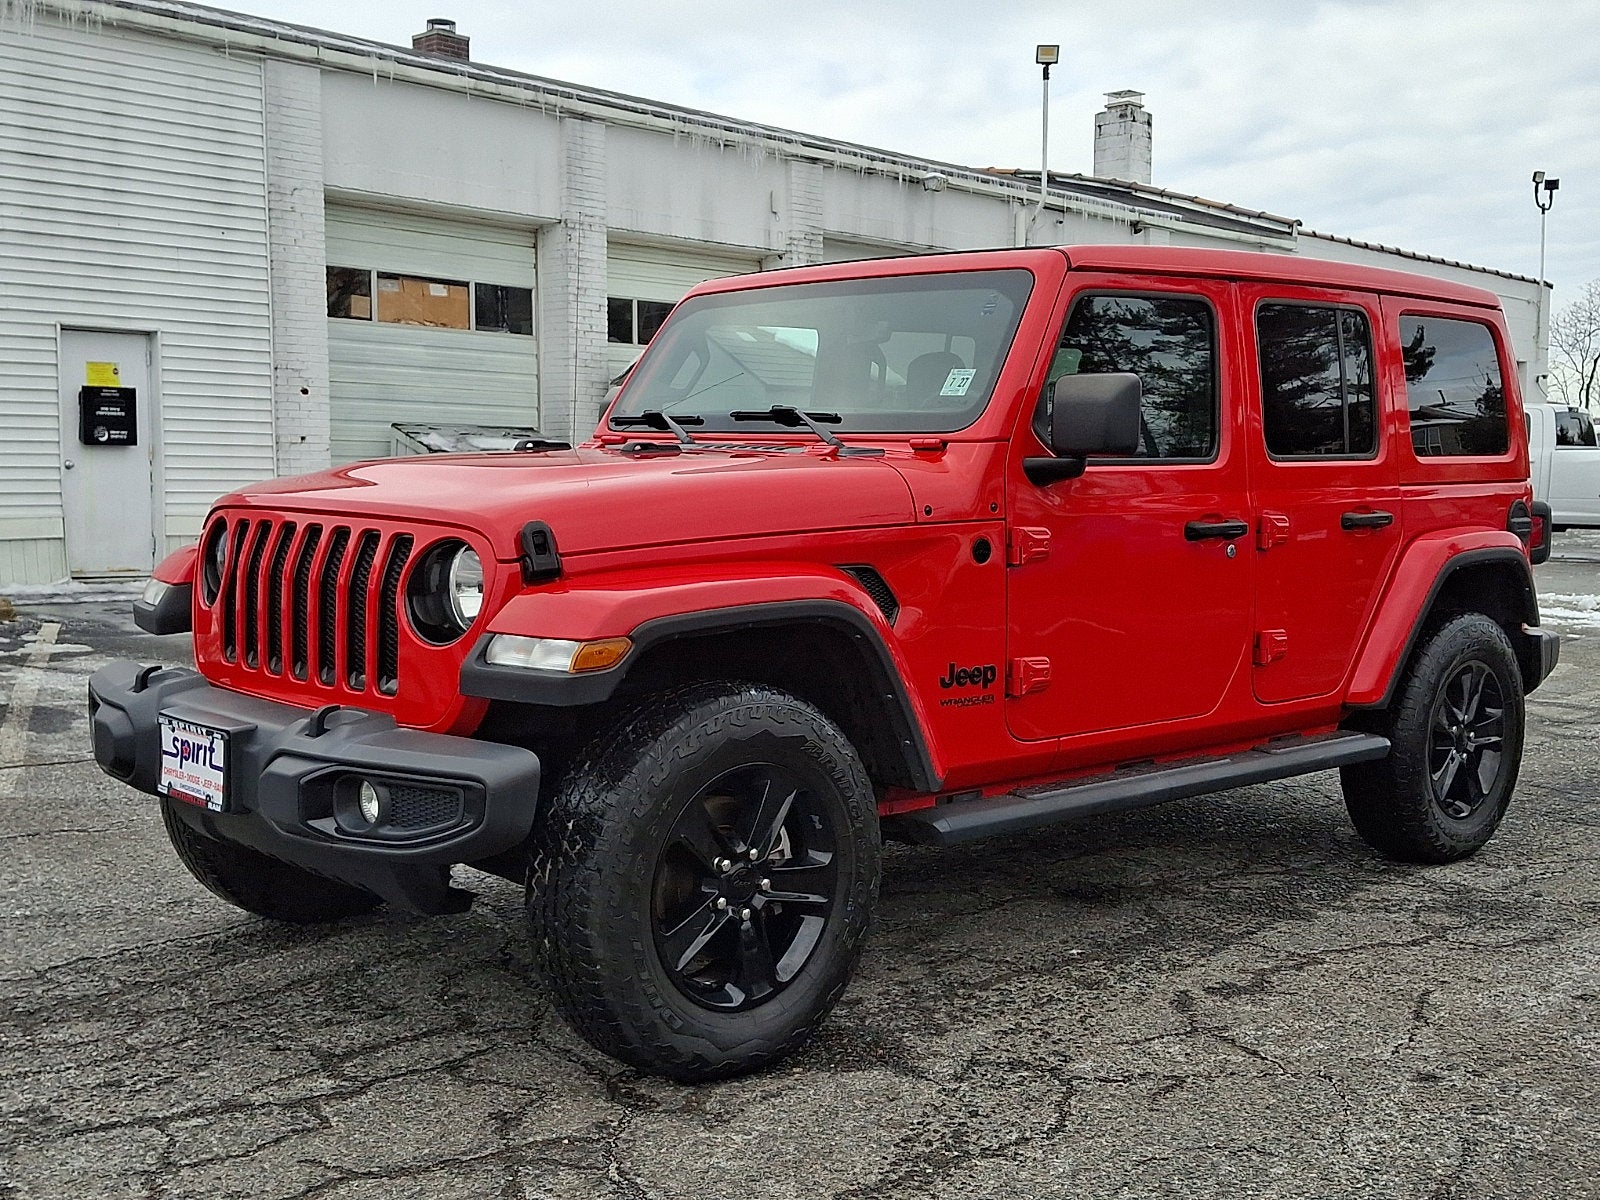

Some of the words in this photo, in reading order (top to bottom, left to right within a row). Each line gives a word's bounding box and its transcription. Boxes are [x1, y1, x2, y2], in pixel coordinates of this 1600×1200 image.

[949, 377, 956, 387] 7
[957, 377, 970, 388] 27
[939, 661, 997, 689] Jeep
[939, 694, 995, 706] WRANGLER
[162, 735, 224, 771] spirit
[163, 767, 185, 780] CHRYSLER
[186, 773, 201, 786] DODGE
[202, 778, 213, 789] JEEP
